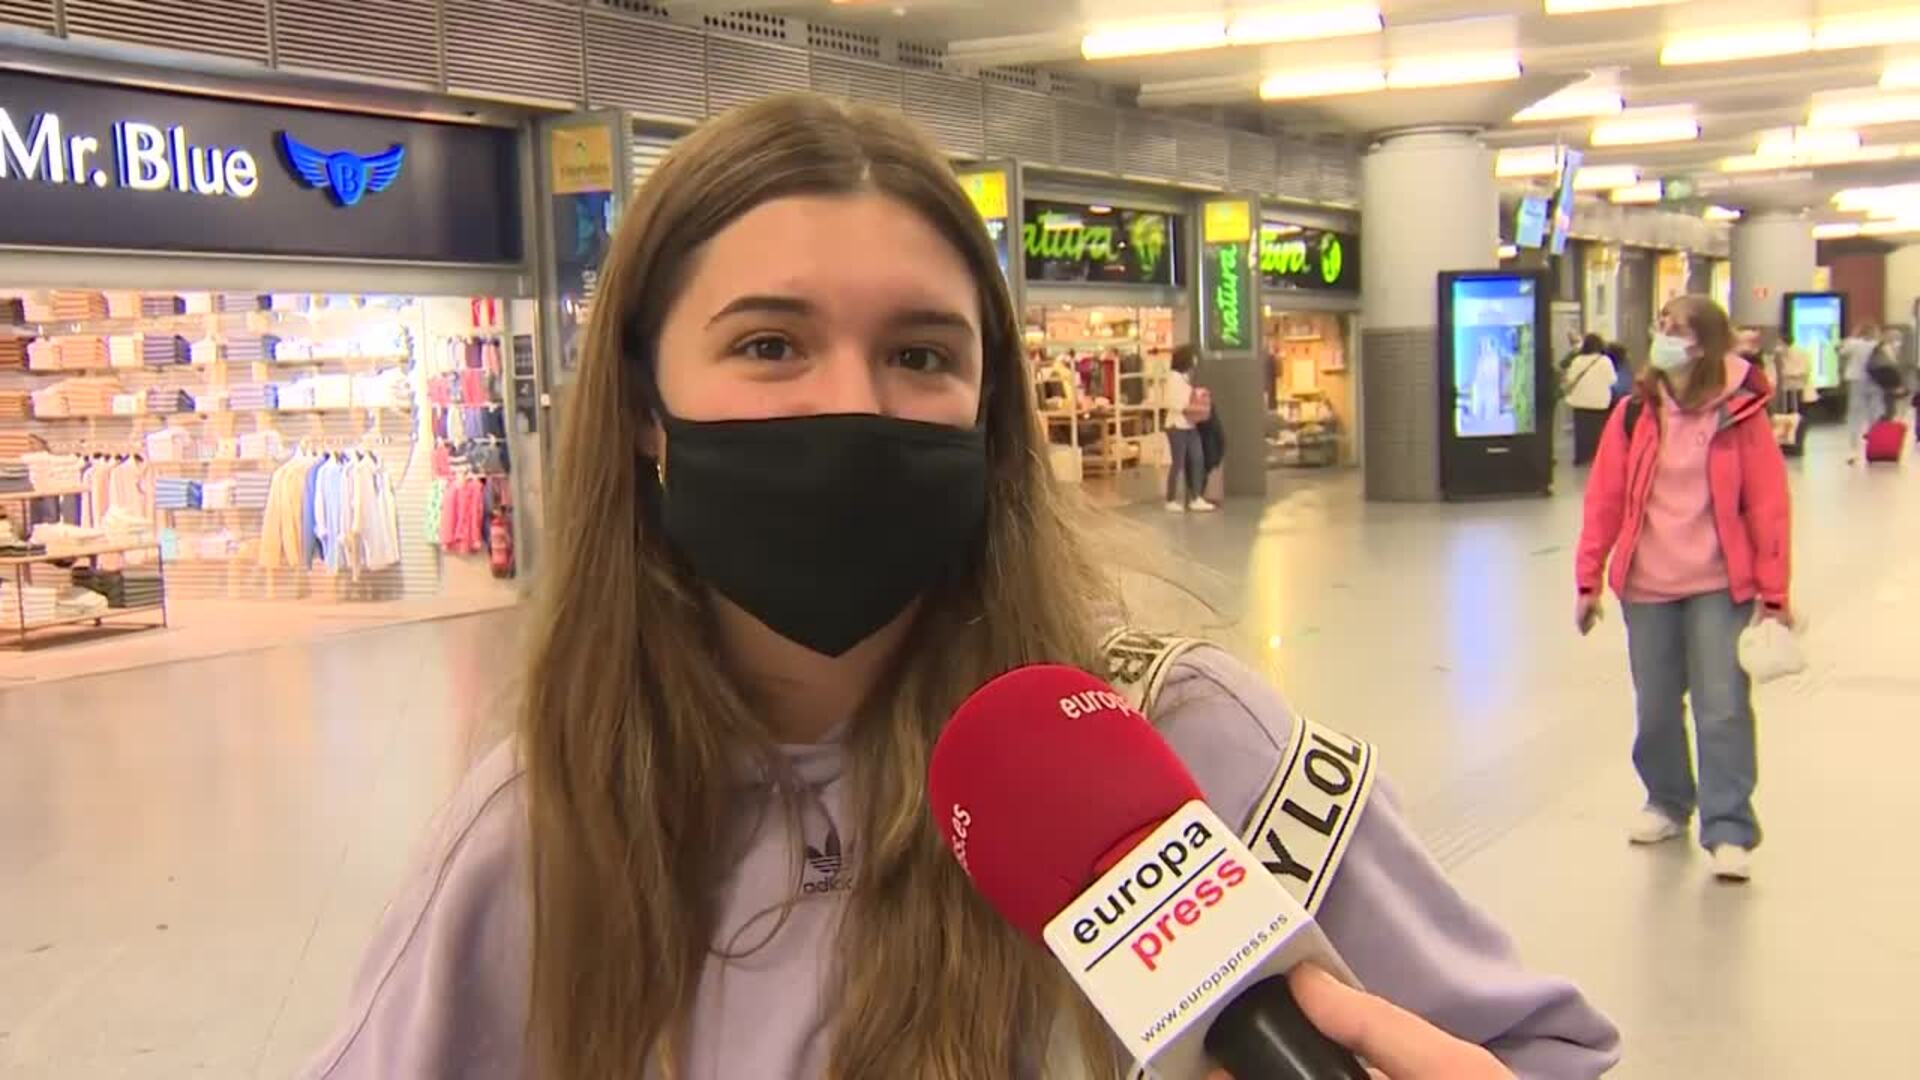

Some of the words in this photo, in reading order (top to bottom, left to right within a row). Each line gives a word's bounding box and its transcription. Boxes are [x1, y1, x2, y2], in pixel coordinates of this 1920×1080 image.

[0, 107, 107, 187] Mr.
[113, 121, 259, 198] Blue
[1217, 243, 1240, 346] natura
[1071, 819, 1213, 945] europa
[1262, 828, 1313, 883] Y
[1130, 857, 1248, 971] press
[1140, 913, 1288, 1043] www.europapress.es
